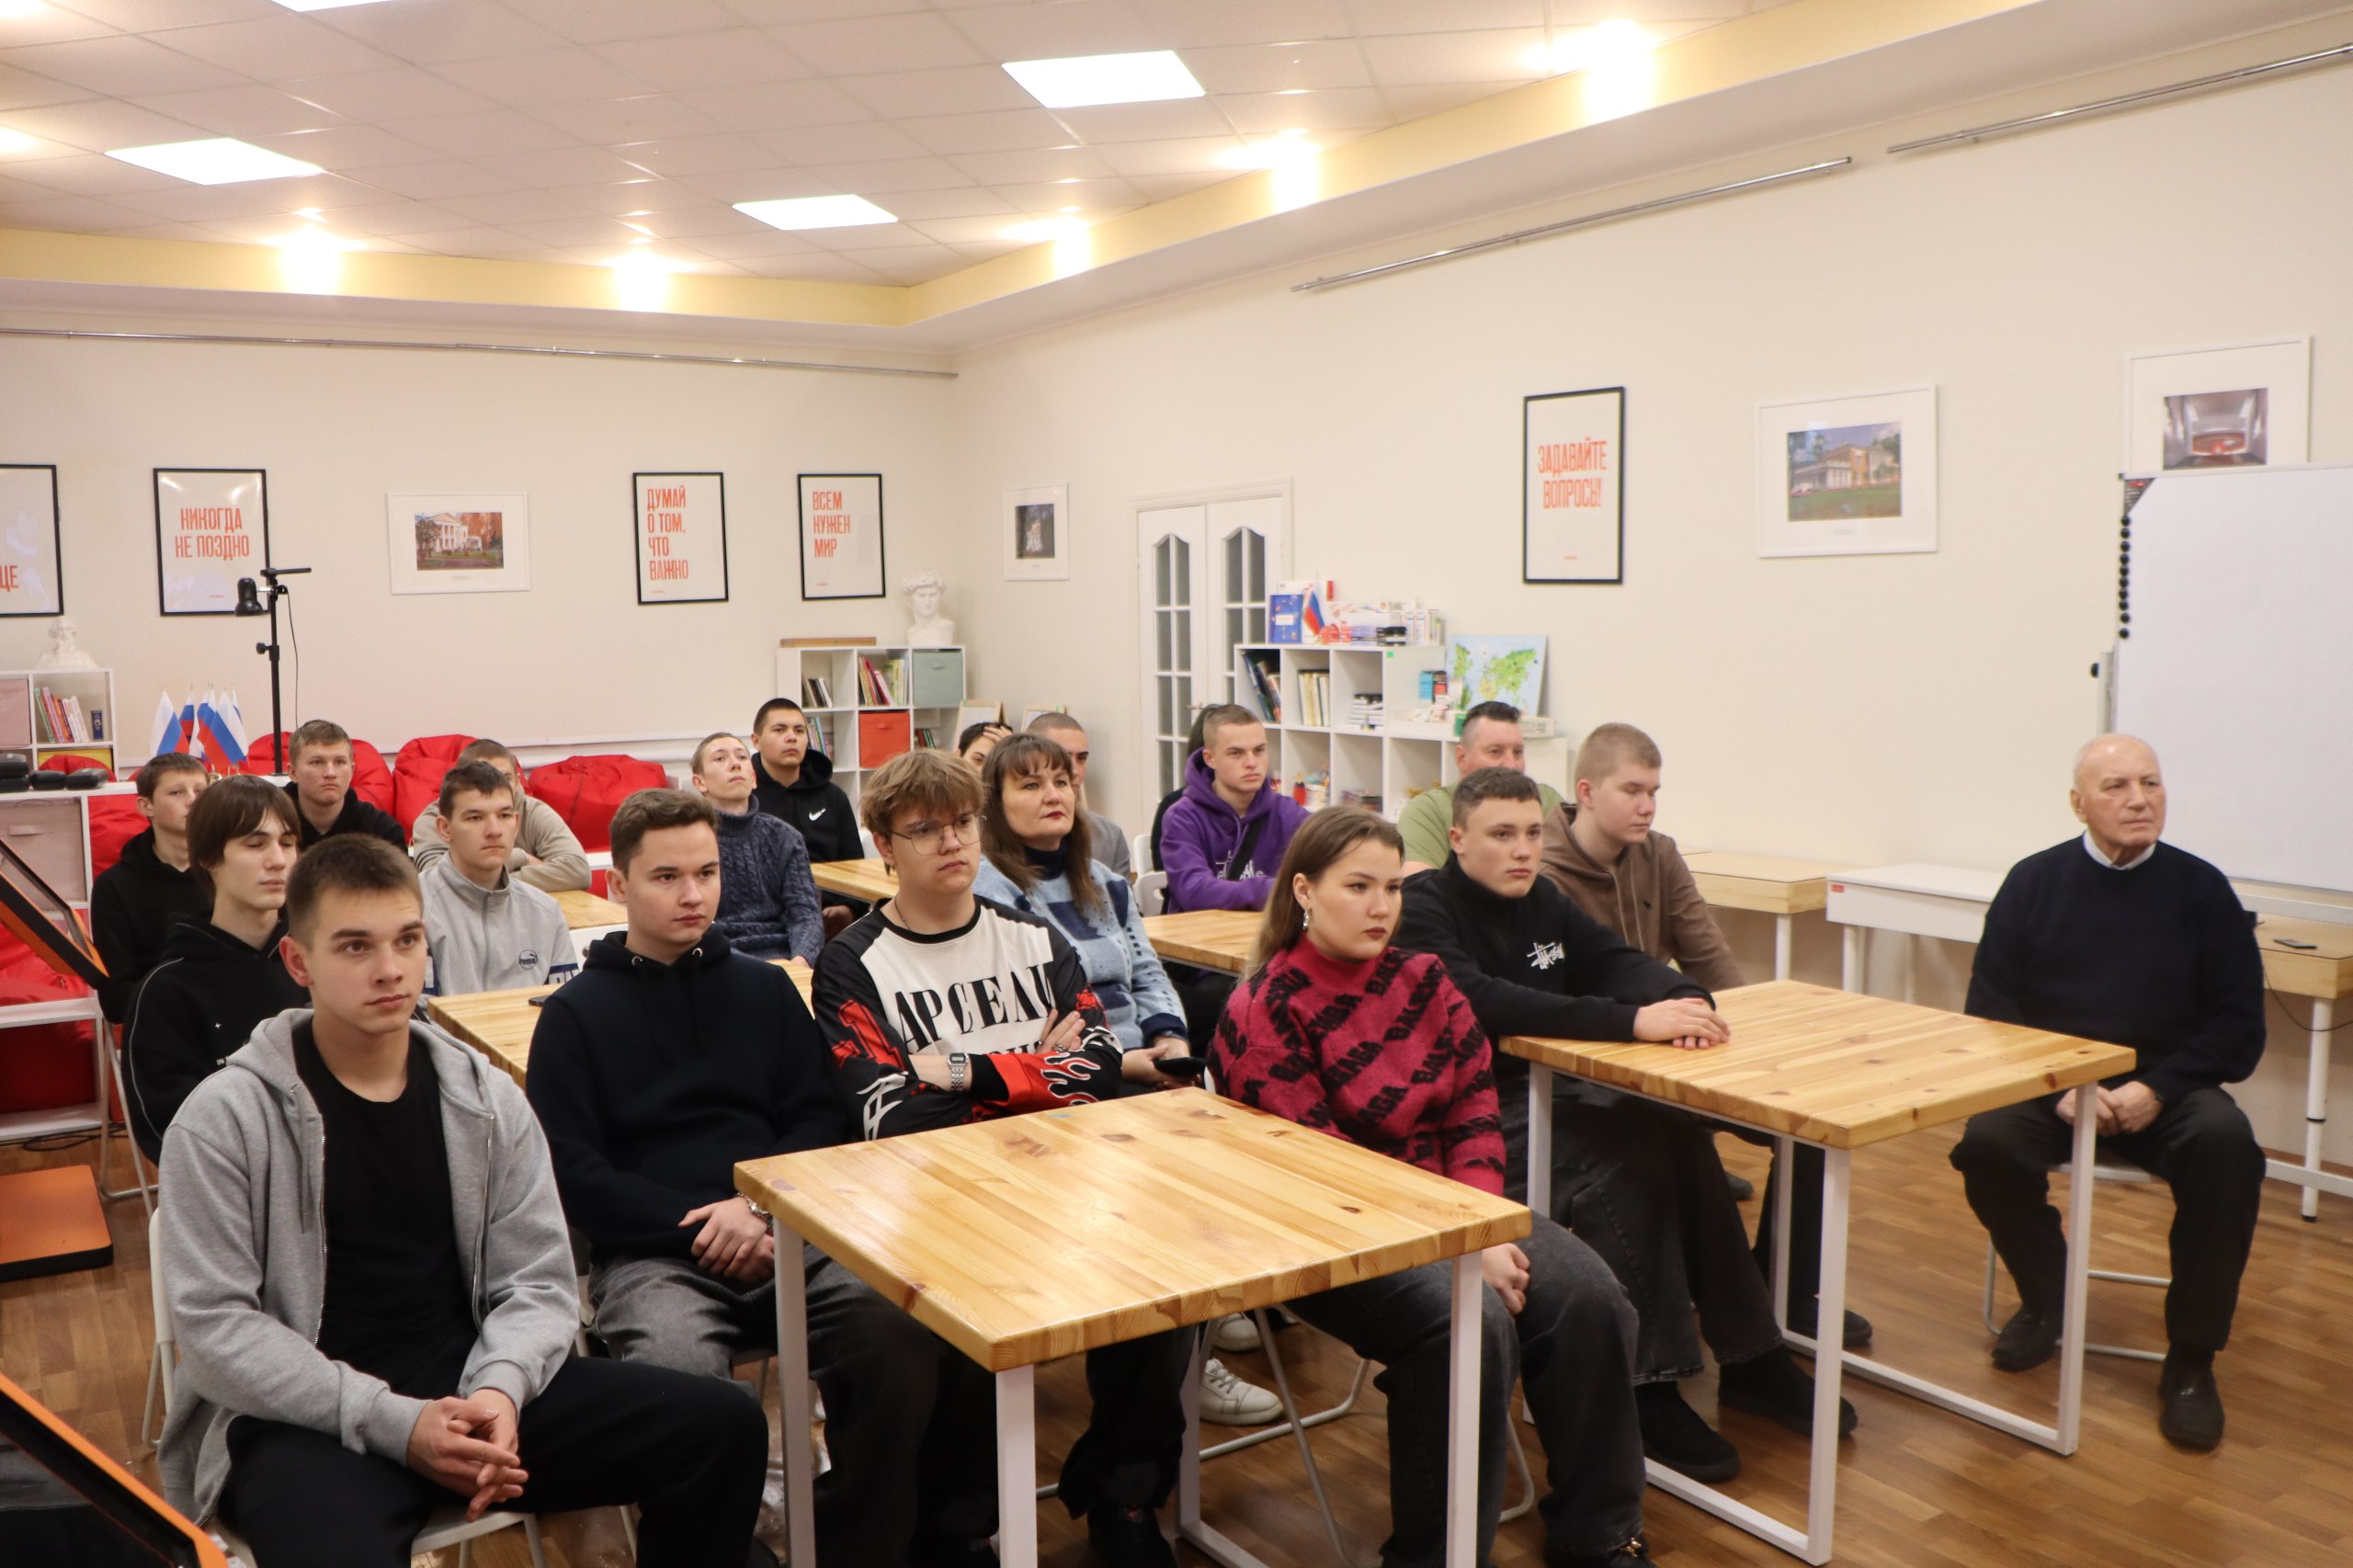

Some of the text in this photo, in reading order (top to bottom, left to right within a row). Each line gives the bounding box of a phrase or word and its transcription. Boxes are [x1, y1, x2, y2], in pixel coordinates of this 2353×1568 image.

[1538, 437, 1608, 477] ЗАДАВАЙТЕ
[647, 485, 687, 512] ДУМАЙ
[813, 491, 843, 511] ВСЕМ
[1543, 477, 1602, 509] ВОПРОСЫ!
[180, 507, 243, 533] НИКОГДА
[647, 513, 687, 535] О ТОМ,
[813, 515, 851, 534] НУЖЕН
[175, 534, 251, 561] НЕ ПОЗДНО
[648, 536, 670, 558] ЧТО
[813, 538, 837, 559] МИР
[649, 559, 689, 581] ВАЖНО
